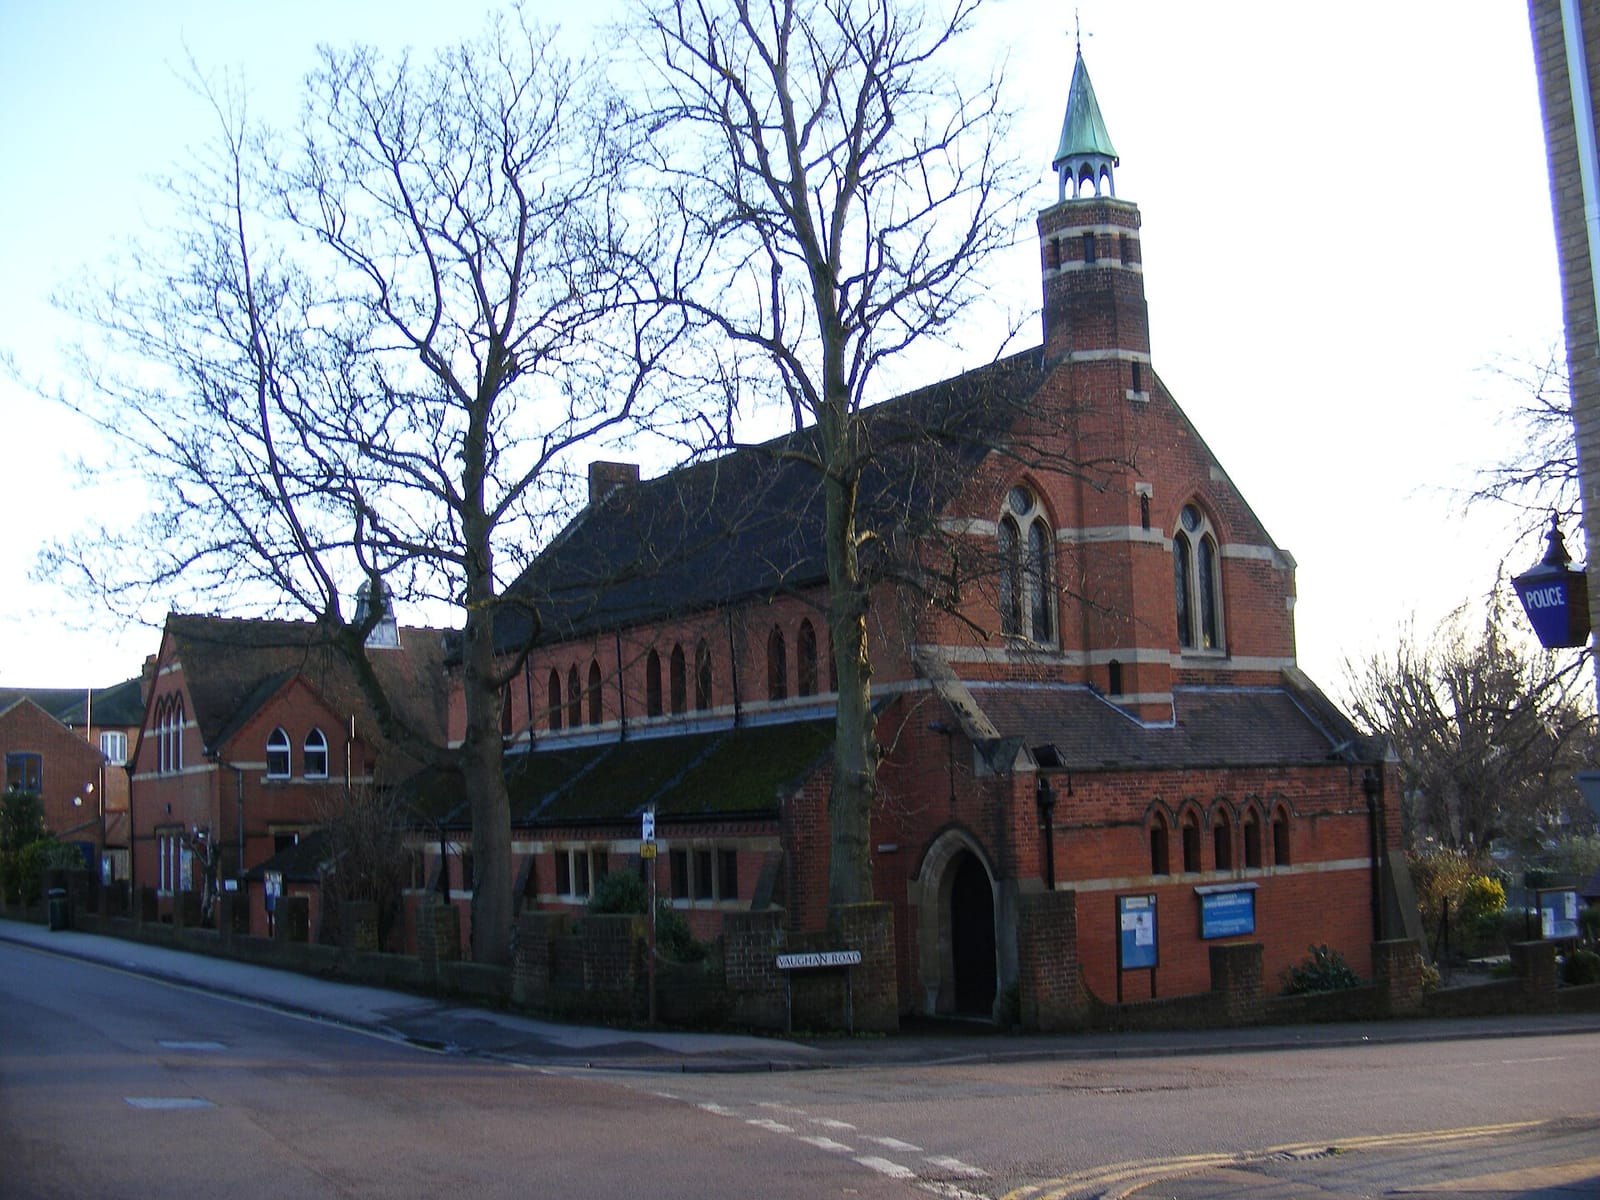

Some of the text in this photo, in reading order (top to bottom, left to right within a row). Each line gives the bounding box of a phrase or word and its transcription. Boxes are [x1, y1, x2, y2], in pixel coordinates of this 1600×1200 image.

[1525, 587, 1565, 609] POLICE
[778, 951, 861, 967] VAUGHAN ROAD
